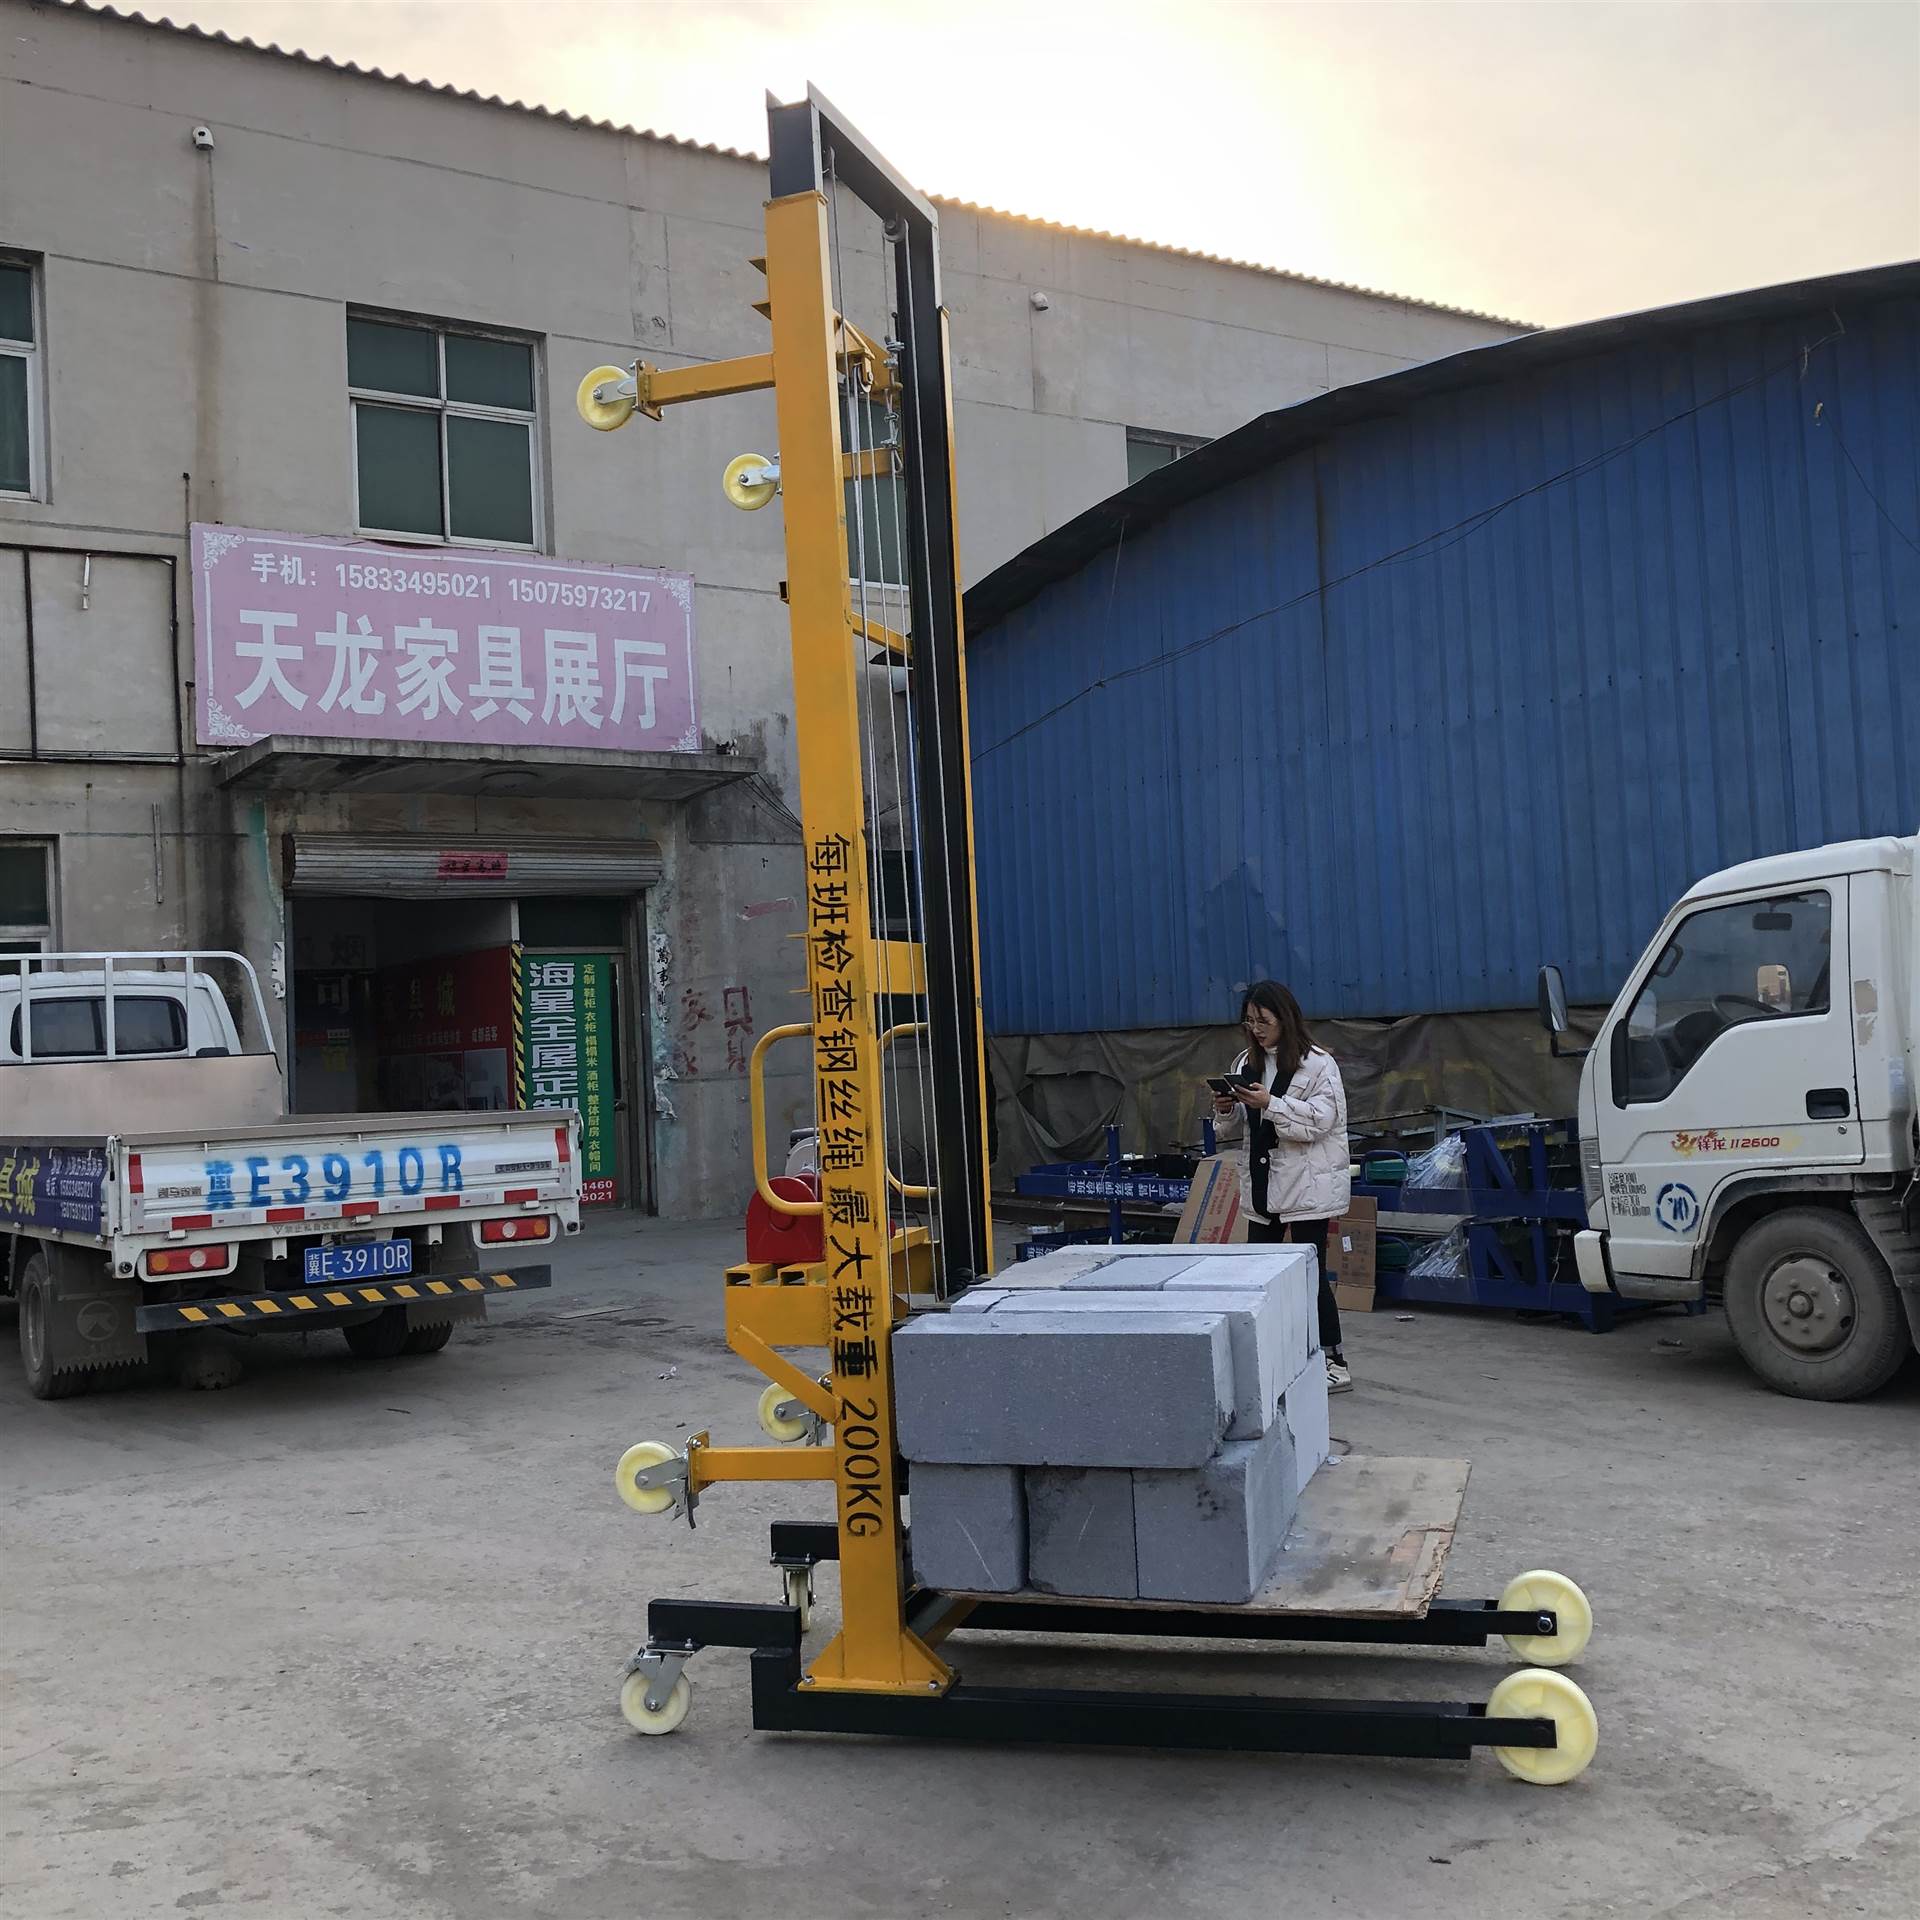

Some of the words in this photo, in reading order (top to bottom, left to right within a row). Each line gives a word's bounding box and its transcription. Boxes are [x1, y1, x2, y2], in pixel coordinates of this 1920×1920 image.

[335, 563, 492, 600] 15833495021
[508, 578, 651, 613] 15075973217
[234, 608, 670, 729] 天龙家具展厅
[840, 1397, 884, 1538] 200KG
